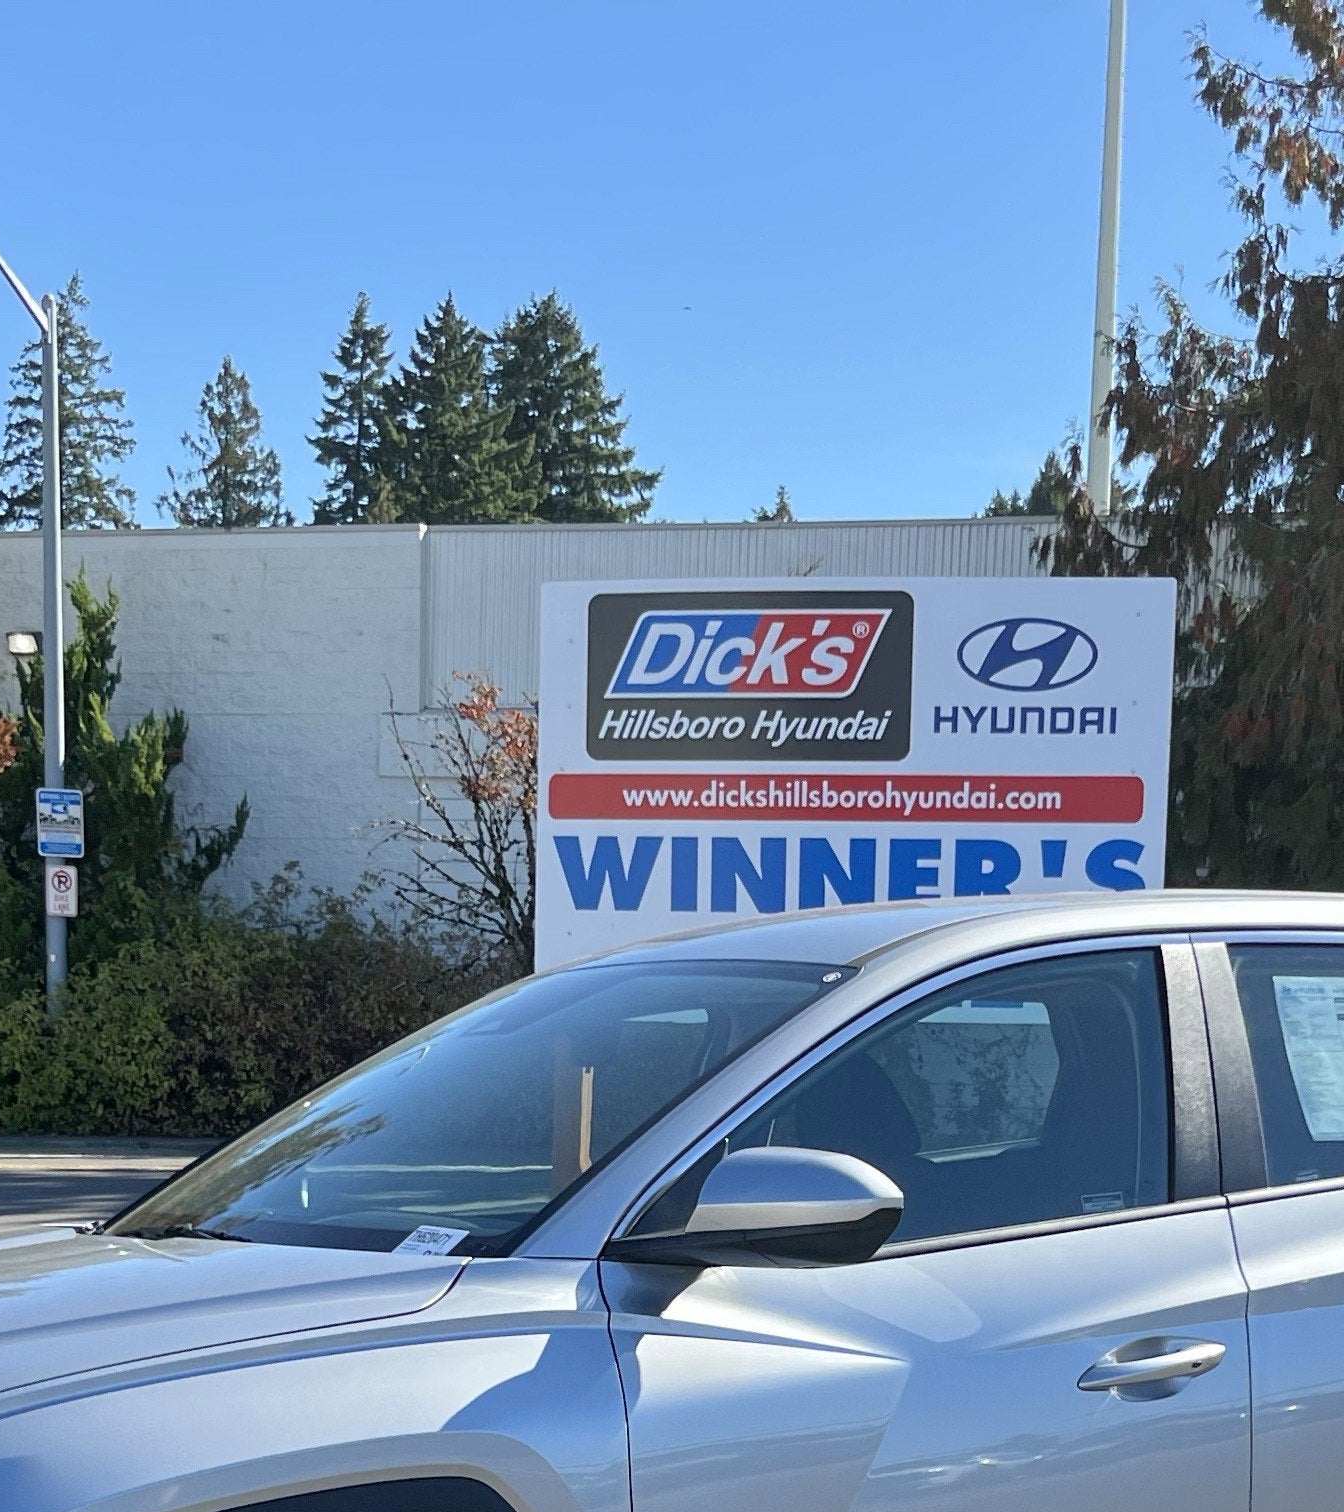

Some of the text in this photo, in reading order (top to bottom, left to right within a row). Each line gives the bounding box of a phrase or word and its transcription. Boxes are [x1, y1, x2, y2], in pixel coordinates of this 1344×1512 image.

[599, 709, 892, 747] Hillsboro Hyundai
[934, 706, 1118, 734] HYUNDAI
[622, 779, 1063, 816] www.dickshillsborohyundai.com
[553, 836, 1146, 913] WINNER'S
